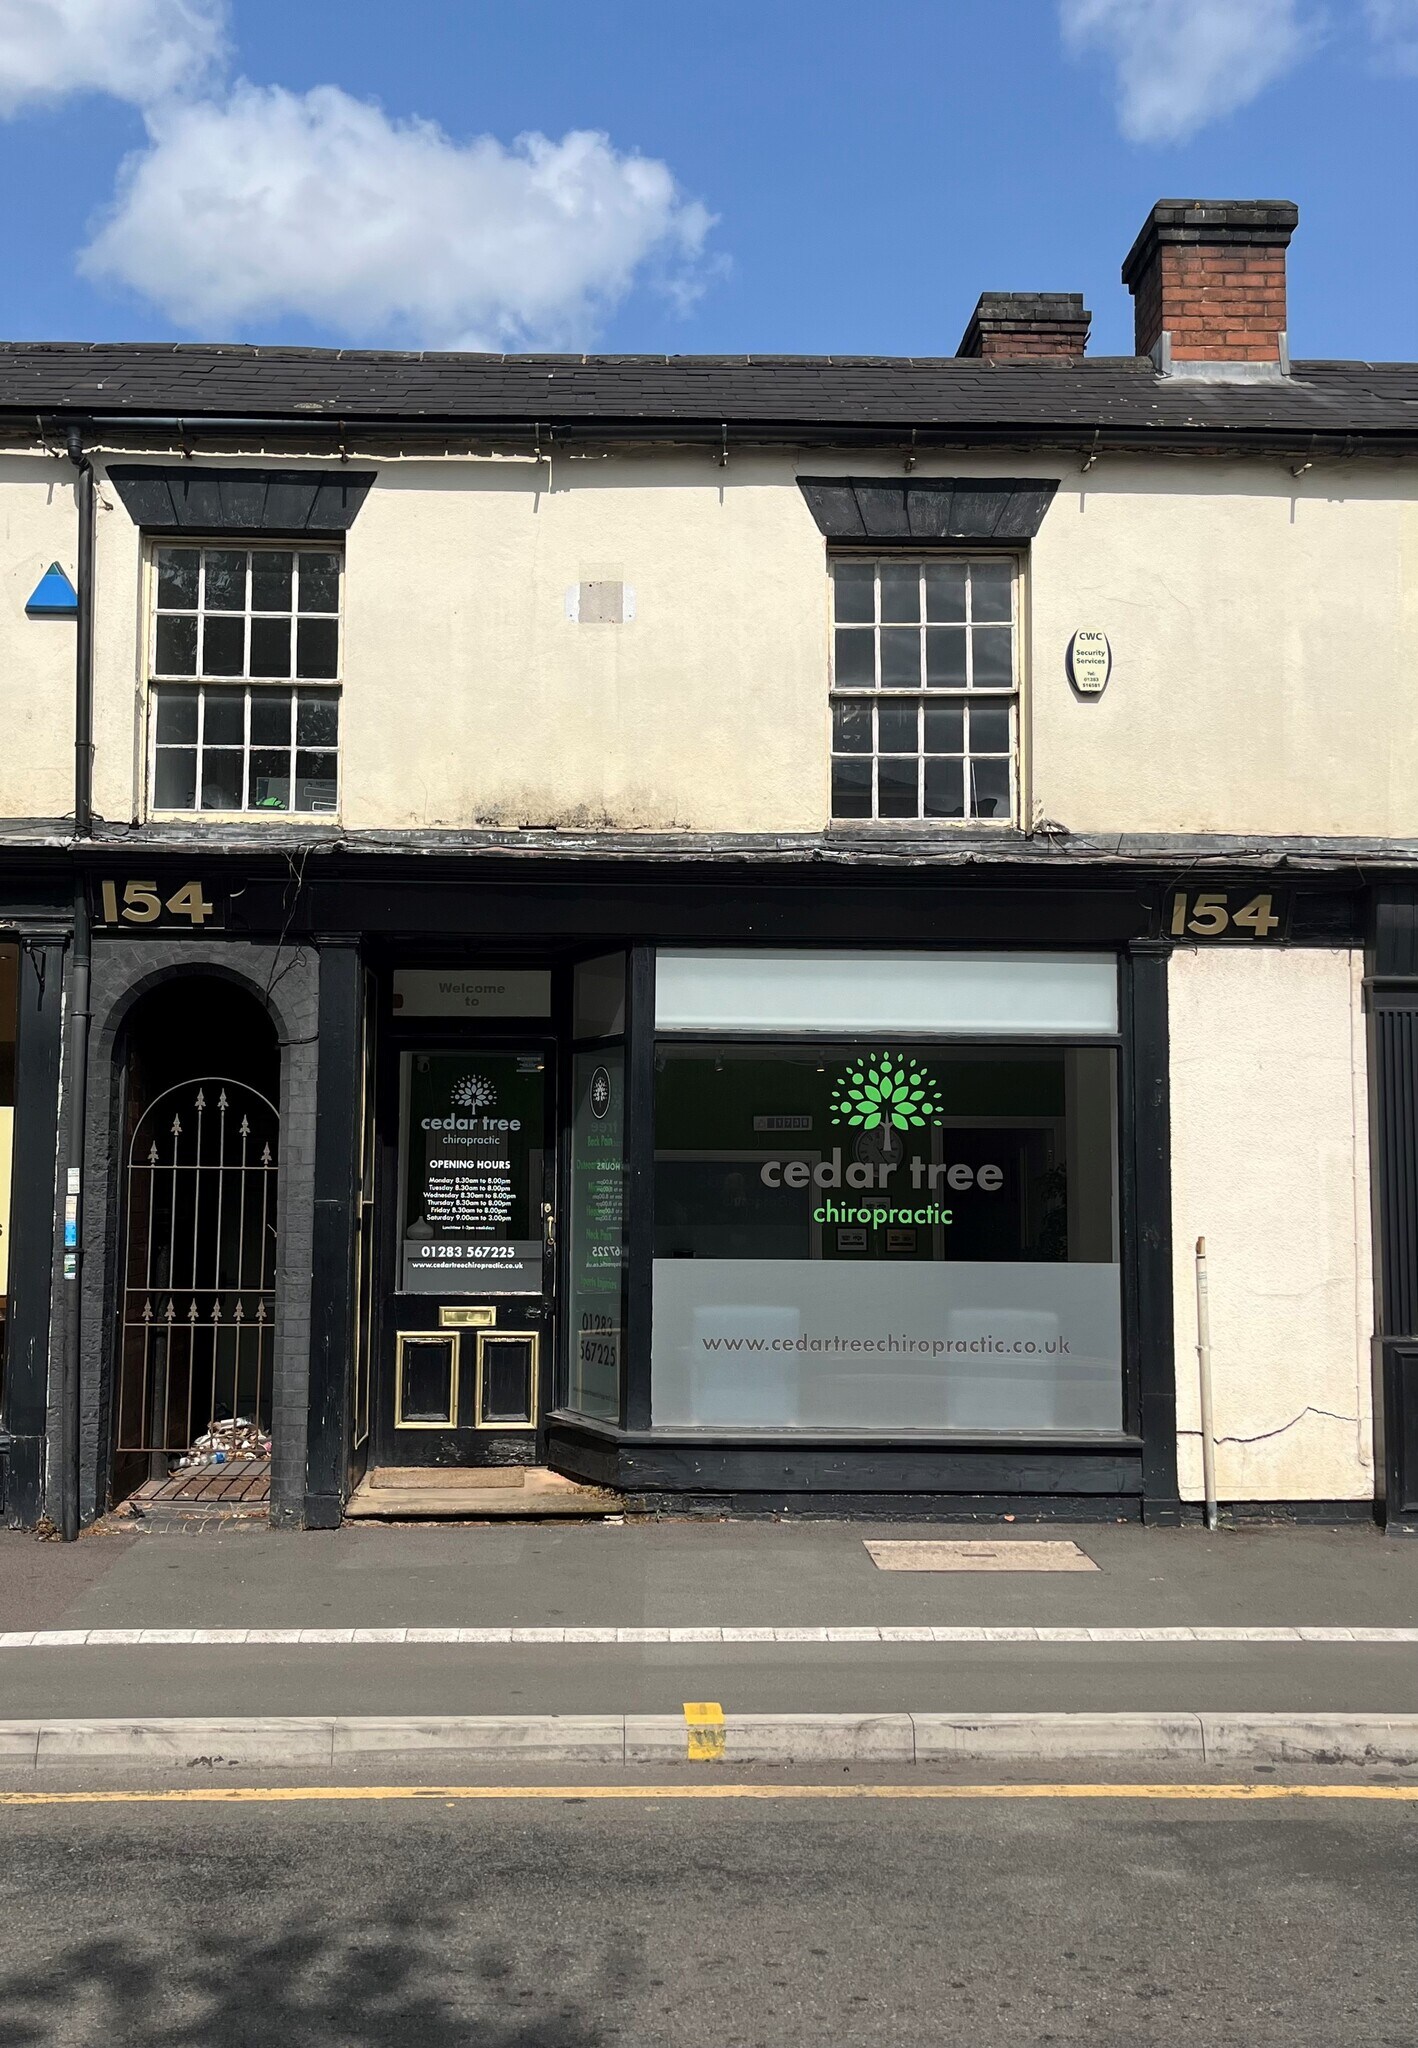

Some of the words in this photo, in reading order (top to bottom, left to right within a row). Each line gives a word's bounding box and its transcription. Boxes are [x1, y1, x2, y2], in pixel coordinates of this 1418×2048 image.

[1079, 632, 1103, 641] CWC
[1076, 649, 1106, 657] Security
[101, 880, 213, 924] 154
[1171, 893, 1279, 936] 154
[438, 982, 505, 995] Welcome
[465, 996, 480, 1007] to
[421, 1112, 478, 1130] cedar
[482, 1116, 521, 1131] tree
[442, 1133, 500, 1147] chiropractic
[429, 1160, 475, 1169] OPENING
[476, 1160, 511, 1170] HOURS
[760, 1148, 899, 1189] cedar
[909, 1157, 1004, 1191] tree
[428, 1177, 454, 1185] Monday
[487, 1177, 511, 1185] 8.00pm
[813, 1199, 953, 1230] chiropractic
[421, 1246, 462, 1258] 01283
[466, 1246, 515, 1258] 567225
[412, 1262, 524, 1270] www.cedartreechiropractic.co.uk
[582, 1313, 613, 1336] 01283
[702, 1333, 1071, 1357] www.cedartreechiropractic.co.uk
[580, 1341, 616, 1367] 567225
